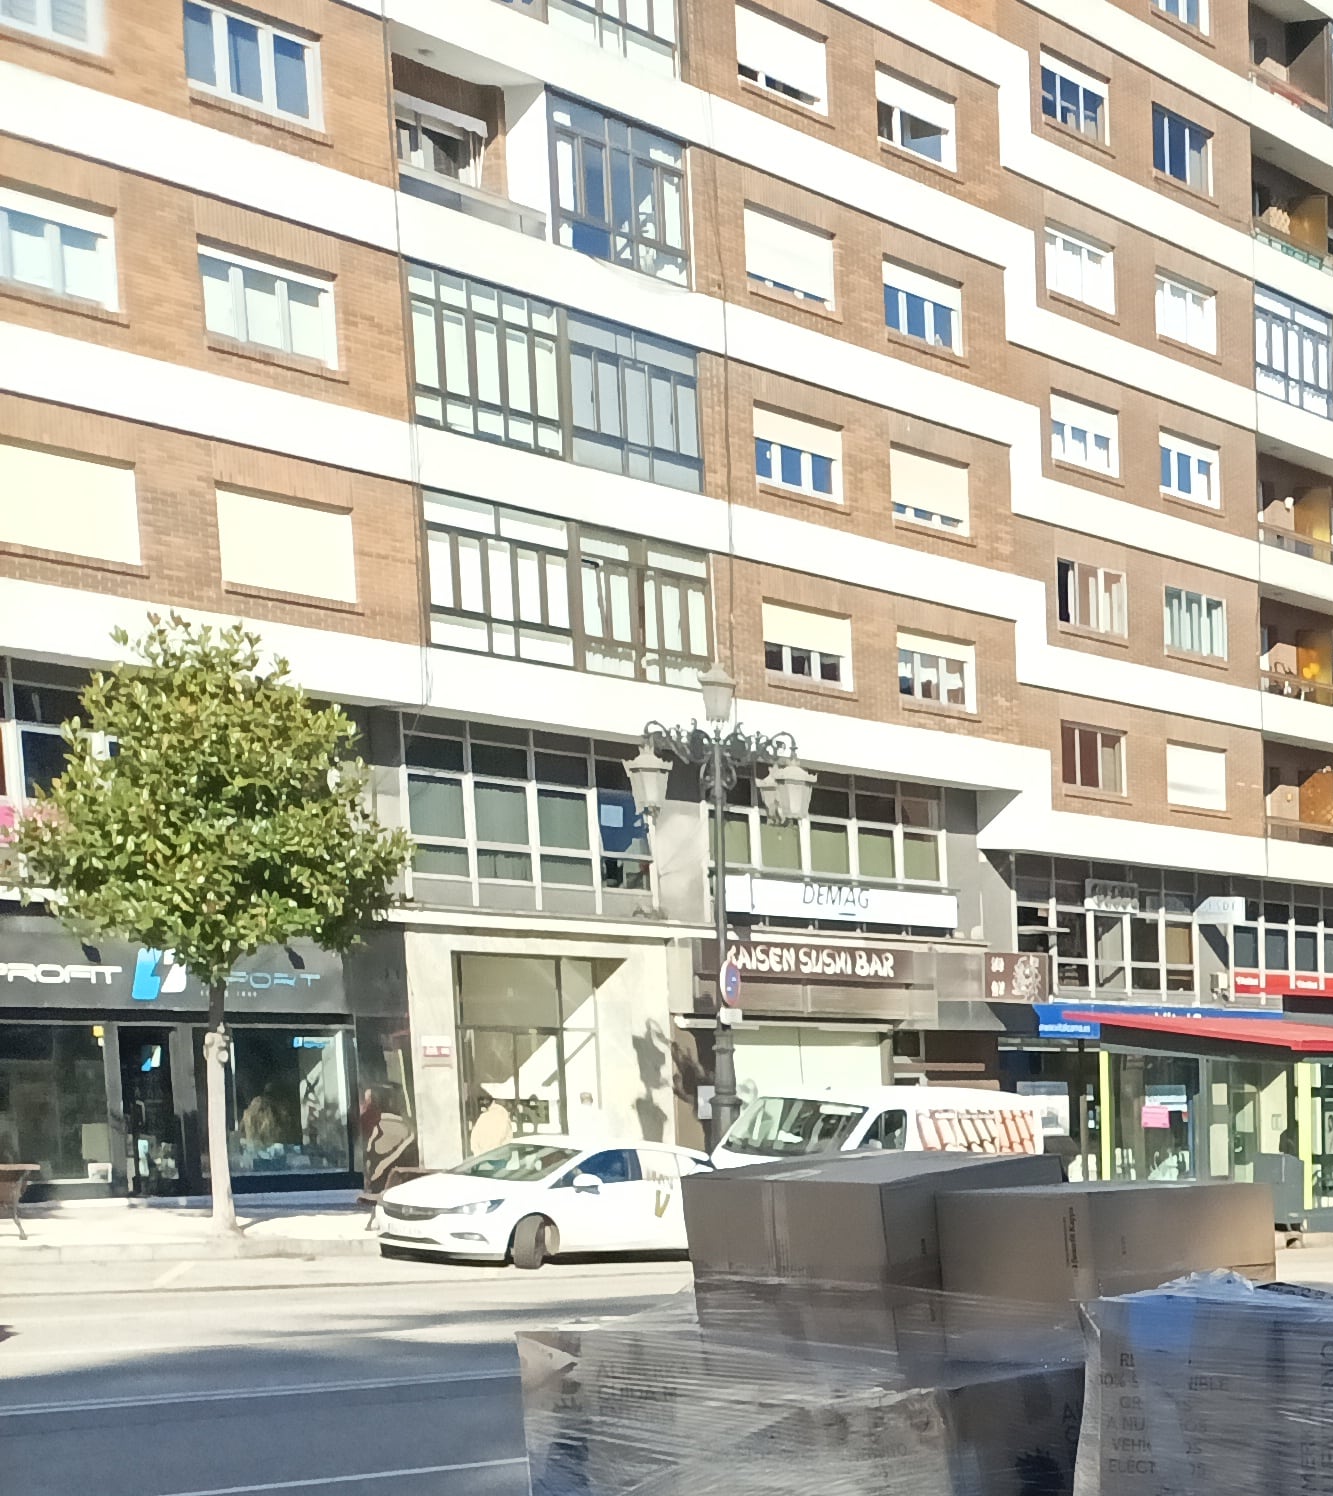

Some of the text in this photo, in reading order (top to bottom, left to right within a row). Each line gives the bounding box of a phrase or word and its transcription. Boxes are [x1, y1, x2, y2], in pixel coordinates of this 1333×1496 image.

[803, 884, 869, 909] DEMAG
[799, 948, 853, 975] SUSHI
[855, 950, 895, 978] BAR
